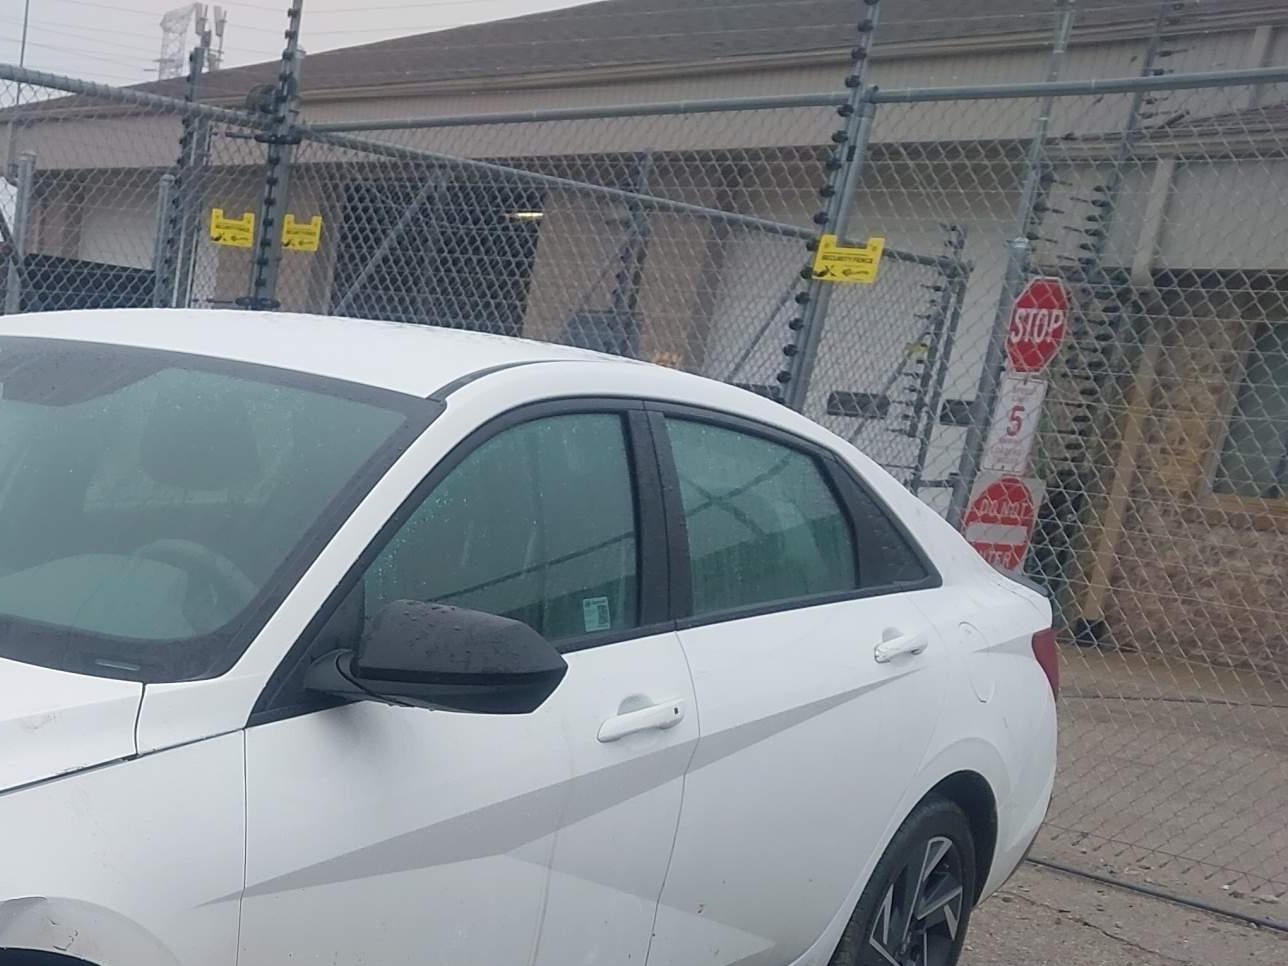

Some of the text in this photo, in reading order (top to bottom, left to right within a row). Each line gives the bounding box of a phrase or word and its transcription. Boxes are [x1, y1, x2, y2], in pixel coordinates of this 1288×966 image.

[1011, 308, 1063, 343] STOP
[1006, 405, 1025, 437] 5
[979, 498, 1028, 519] DO NOT
